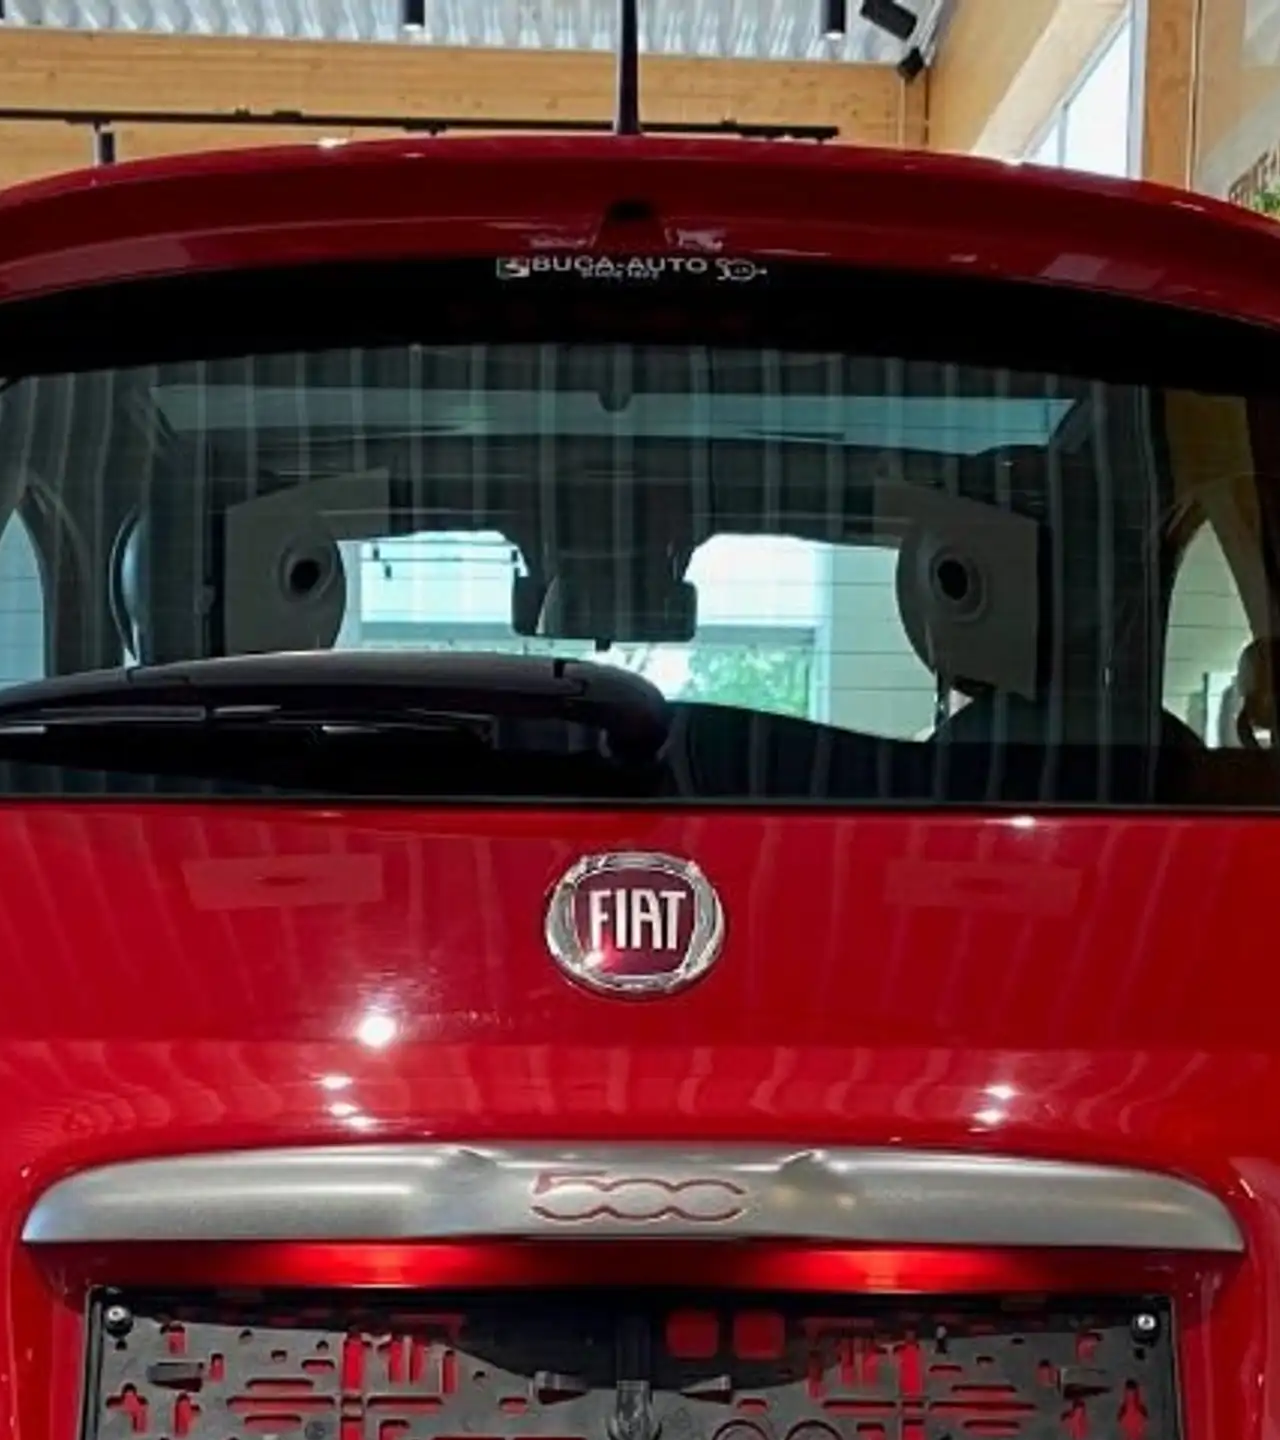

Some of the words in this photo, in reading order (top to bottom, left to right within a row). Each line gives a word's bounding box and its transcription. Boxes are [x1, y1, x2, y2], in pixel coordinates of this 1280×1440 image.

[532, 256, 708, 273] BUGA-AUTO
[589, 888, 687, 951] FIAT
[531, 1170, 746, 1222] 500
